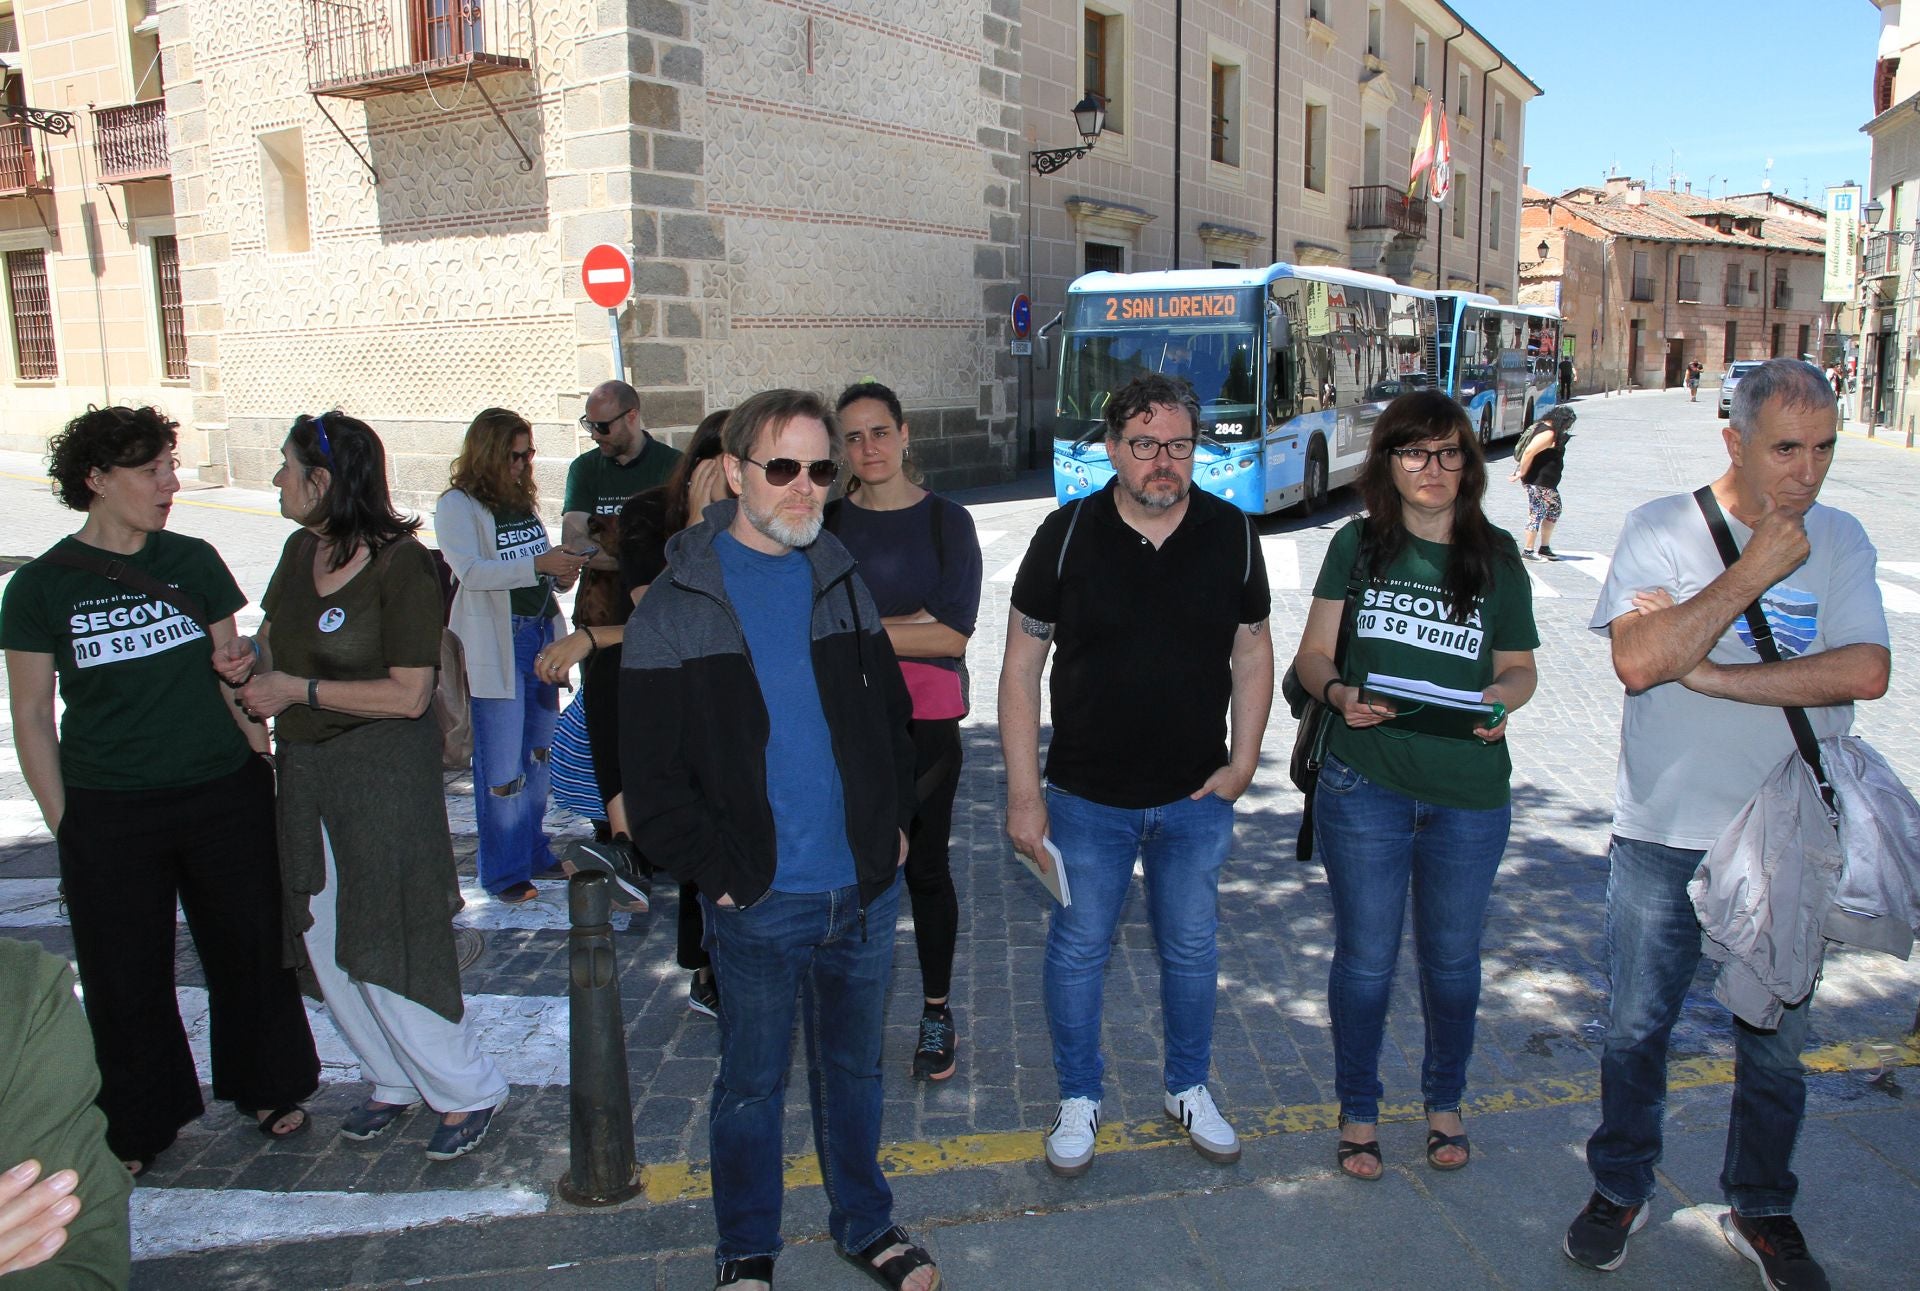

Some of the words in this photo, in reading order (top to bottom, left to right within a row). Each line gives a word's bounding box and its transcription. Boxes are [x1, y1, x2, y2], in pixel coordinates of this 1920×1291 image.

[1828, 217, 1842, 277] habitaciones
[1845, 258, 1853, 276] con
[1106, 298, 1118, 321] 2
[1122, 298, 1154, 319] SAN
[1158, 295, 1236, 317] LORENZO
[1215, 423, 1243, 435] 2842
[500, 550, 517, 561] no
[529, 541, 547, 556] ven
[111, 594, 119, 602] el
[121, 593, 147, 601] derech
[1413, 582, 1442, 593] derecho
[76, 641, 102, 660] no
[111, 635, 136, 654] se
[140, 616, 202, 649] vende
[1359, 613, 1377, 630] no
[1383, 617, 1408, 635] se
[1417, 624, 1479, 654] vende
